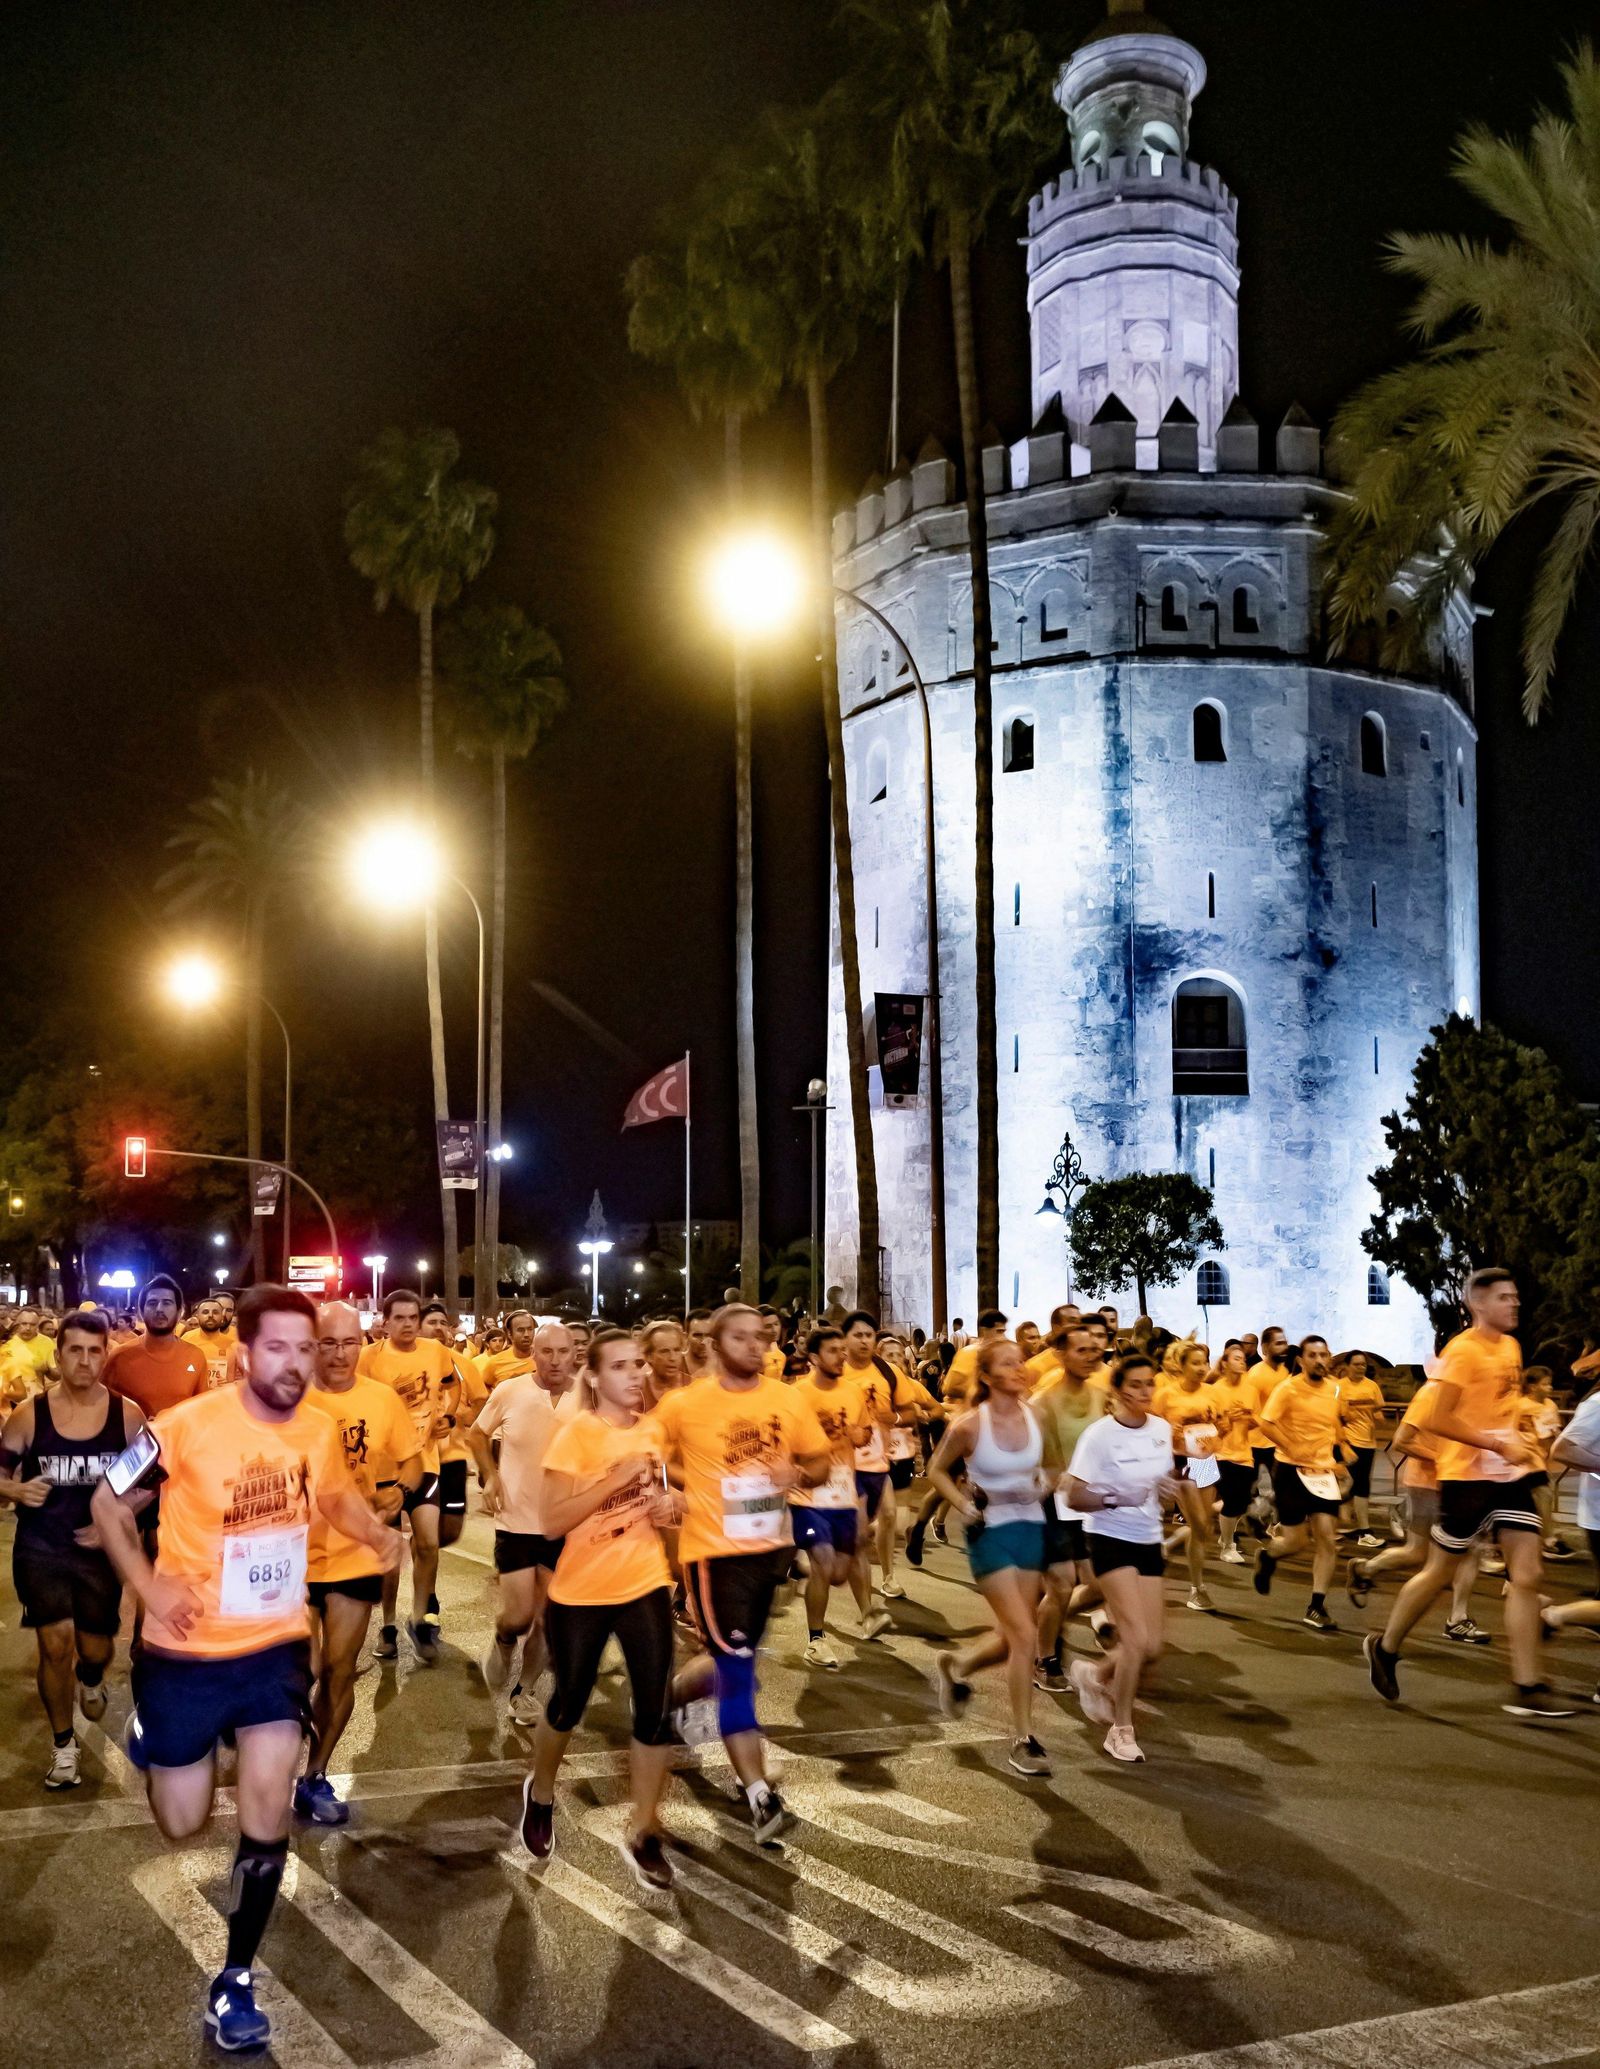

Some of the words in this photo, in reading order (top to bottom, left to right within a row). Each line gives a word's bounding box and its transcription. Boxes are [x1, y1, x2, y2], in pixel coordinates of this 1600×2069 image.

[233, 1471, 287, 1502] CARRERA
[224, 1494, 288, 1525] NOCTURNA
[249, 1558, 291, 1583] 6852
